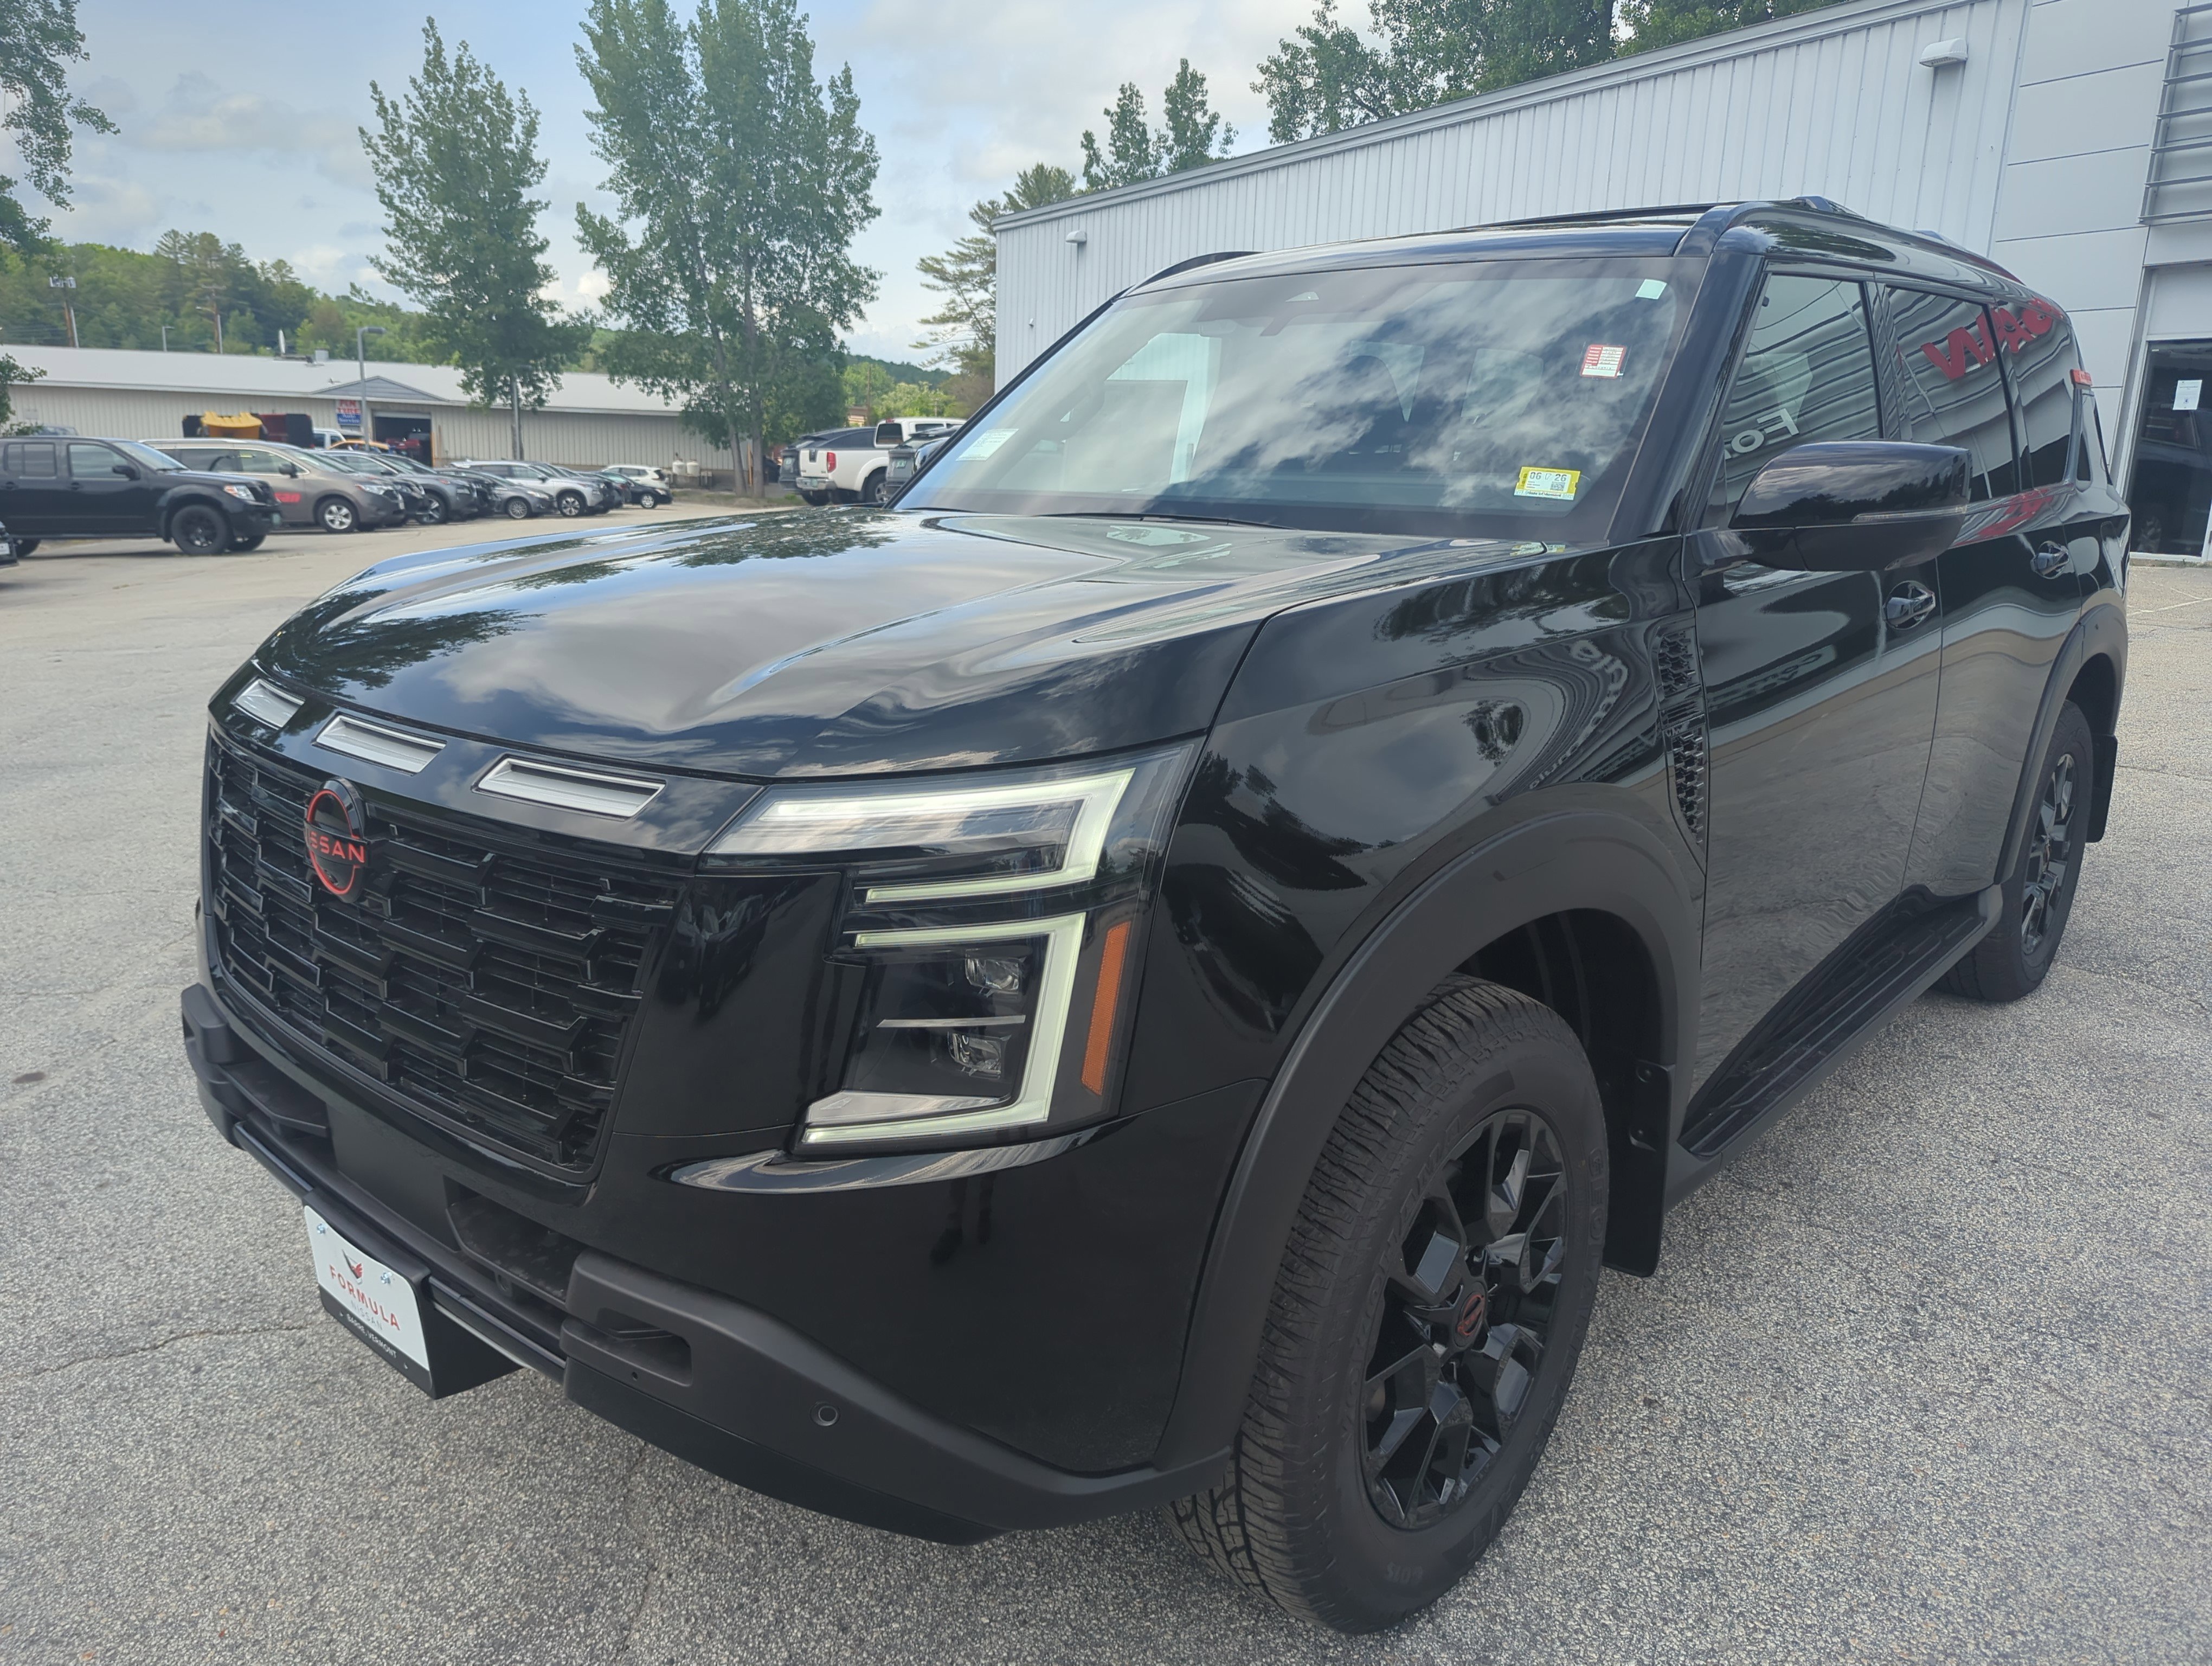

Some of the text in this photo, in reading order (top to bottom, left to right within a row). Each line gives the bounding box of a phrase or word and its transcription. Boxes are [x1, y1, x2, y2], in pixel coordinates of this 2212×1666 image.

[1529, 472, 1542, 480] 06
[307, 831, 365, 863] SSAN
[329, 1265, 401, 1331] FORMULA
[351, 1300, 383, 1330] NISSAN
[367, 1330, 397, 1358] VERMONT
